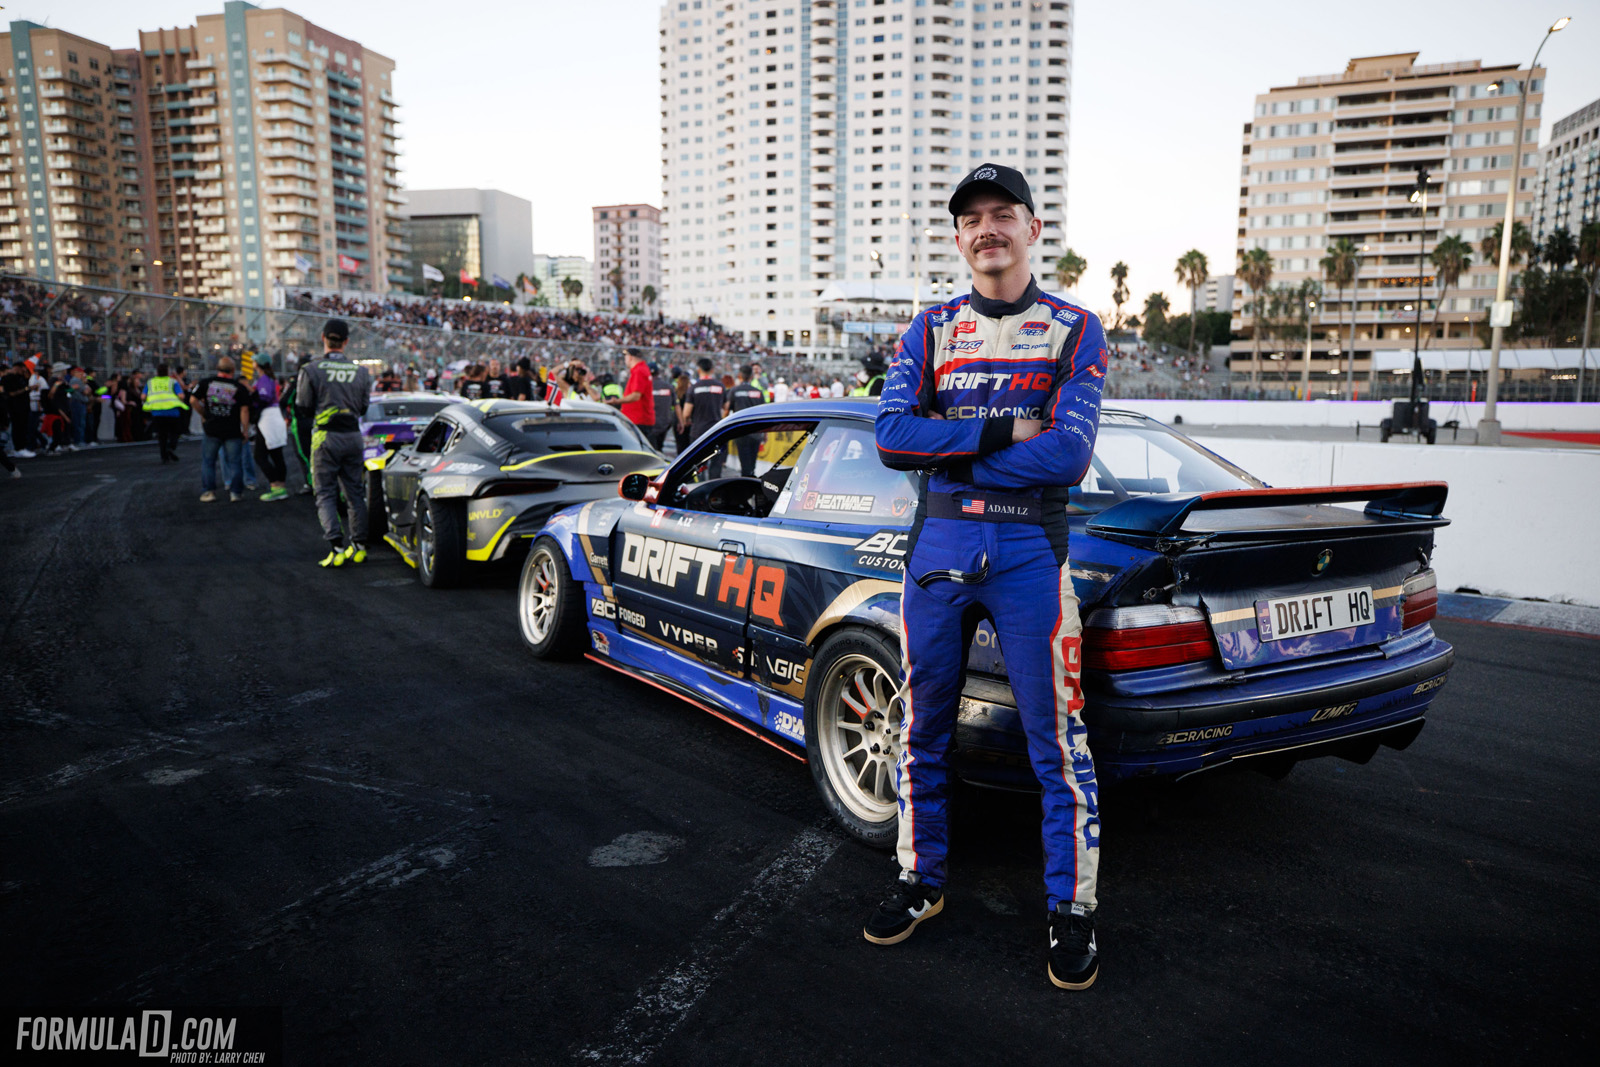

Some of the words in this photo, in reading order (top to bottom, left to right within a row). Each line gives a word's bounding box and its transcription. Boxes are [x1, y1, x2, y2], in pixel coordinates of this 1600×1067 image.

[326, 370, 356, 383] 707
[816, 495, 874, 511] HEATWAVE
[987, 504, 1015, 515] ADAM
[1017, 506, 1029, 515] LZ
[711, 522, 721, 534] 5
[854, 532, 908, 556] BC
[590, 552, 608, 566] Garrett
[591, 598, 616, 620] BC
[618, 607, 646, 628] FORGED
[1275, 596, 1333, 635] DRIFT
[1347, 591, 1371, 622] HQ
[1260, 624, 1272, 635] LZ
[659, 620, 719, 655] VYPER
